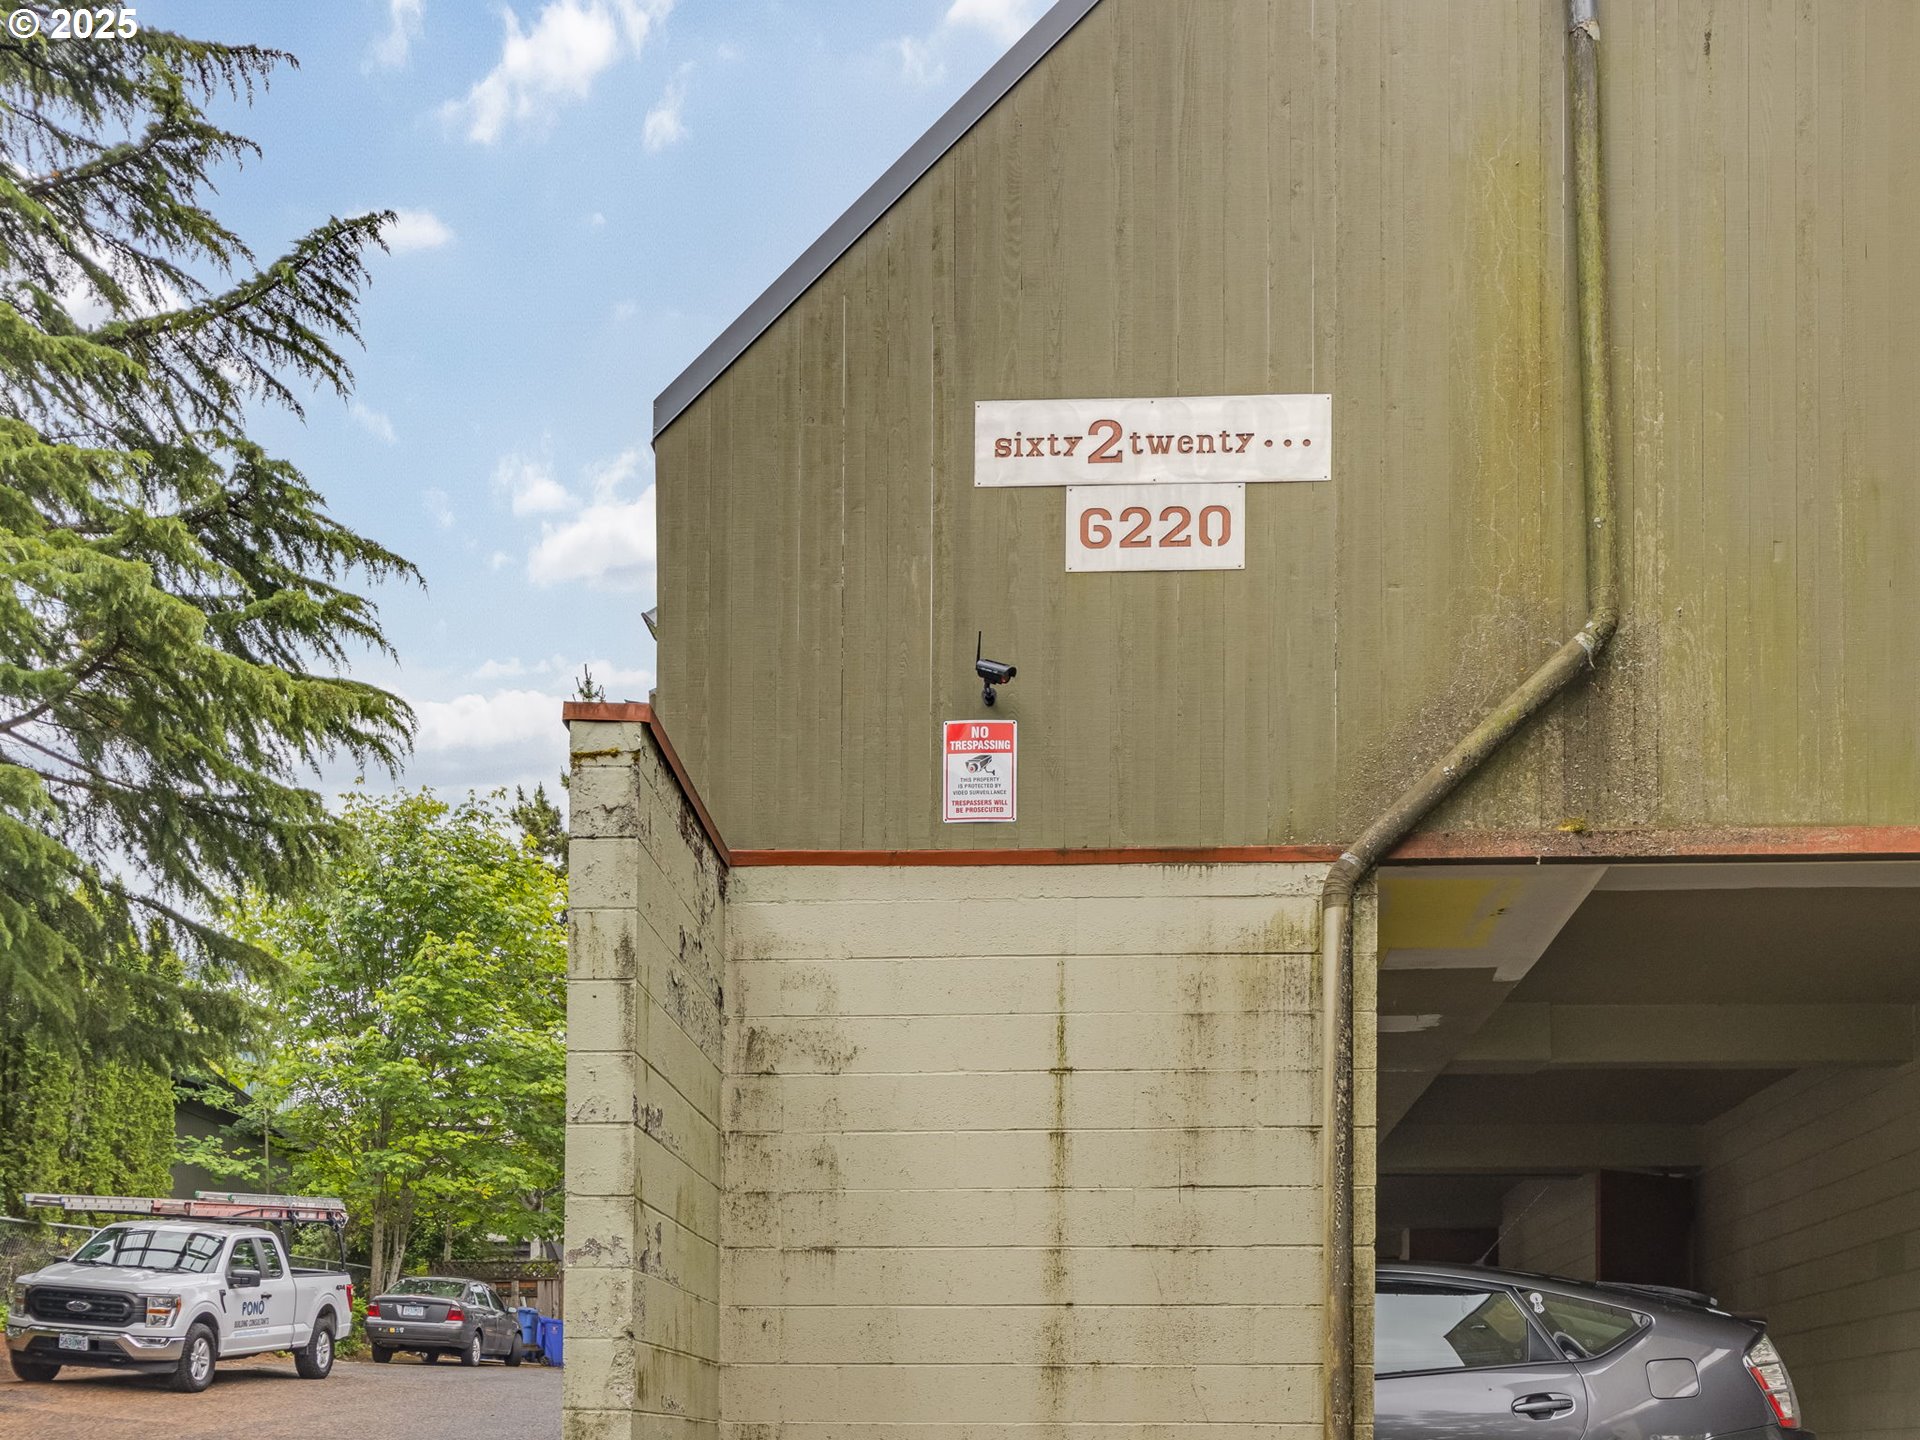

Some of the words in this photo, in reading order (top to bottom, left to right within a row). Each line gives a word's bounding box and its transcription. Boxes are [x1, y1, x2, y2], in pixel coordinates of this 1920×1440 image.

[1080, 504, 1232, 549] 6220
[971, 726, 989, 738] NO
[950, 740, 1010, 750] TRESPASSING
[242, 1301, 264, 1315] PONO
